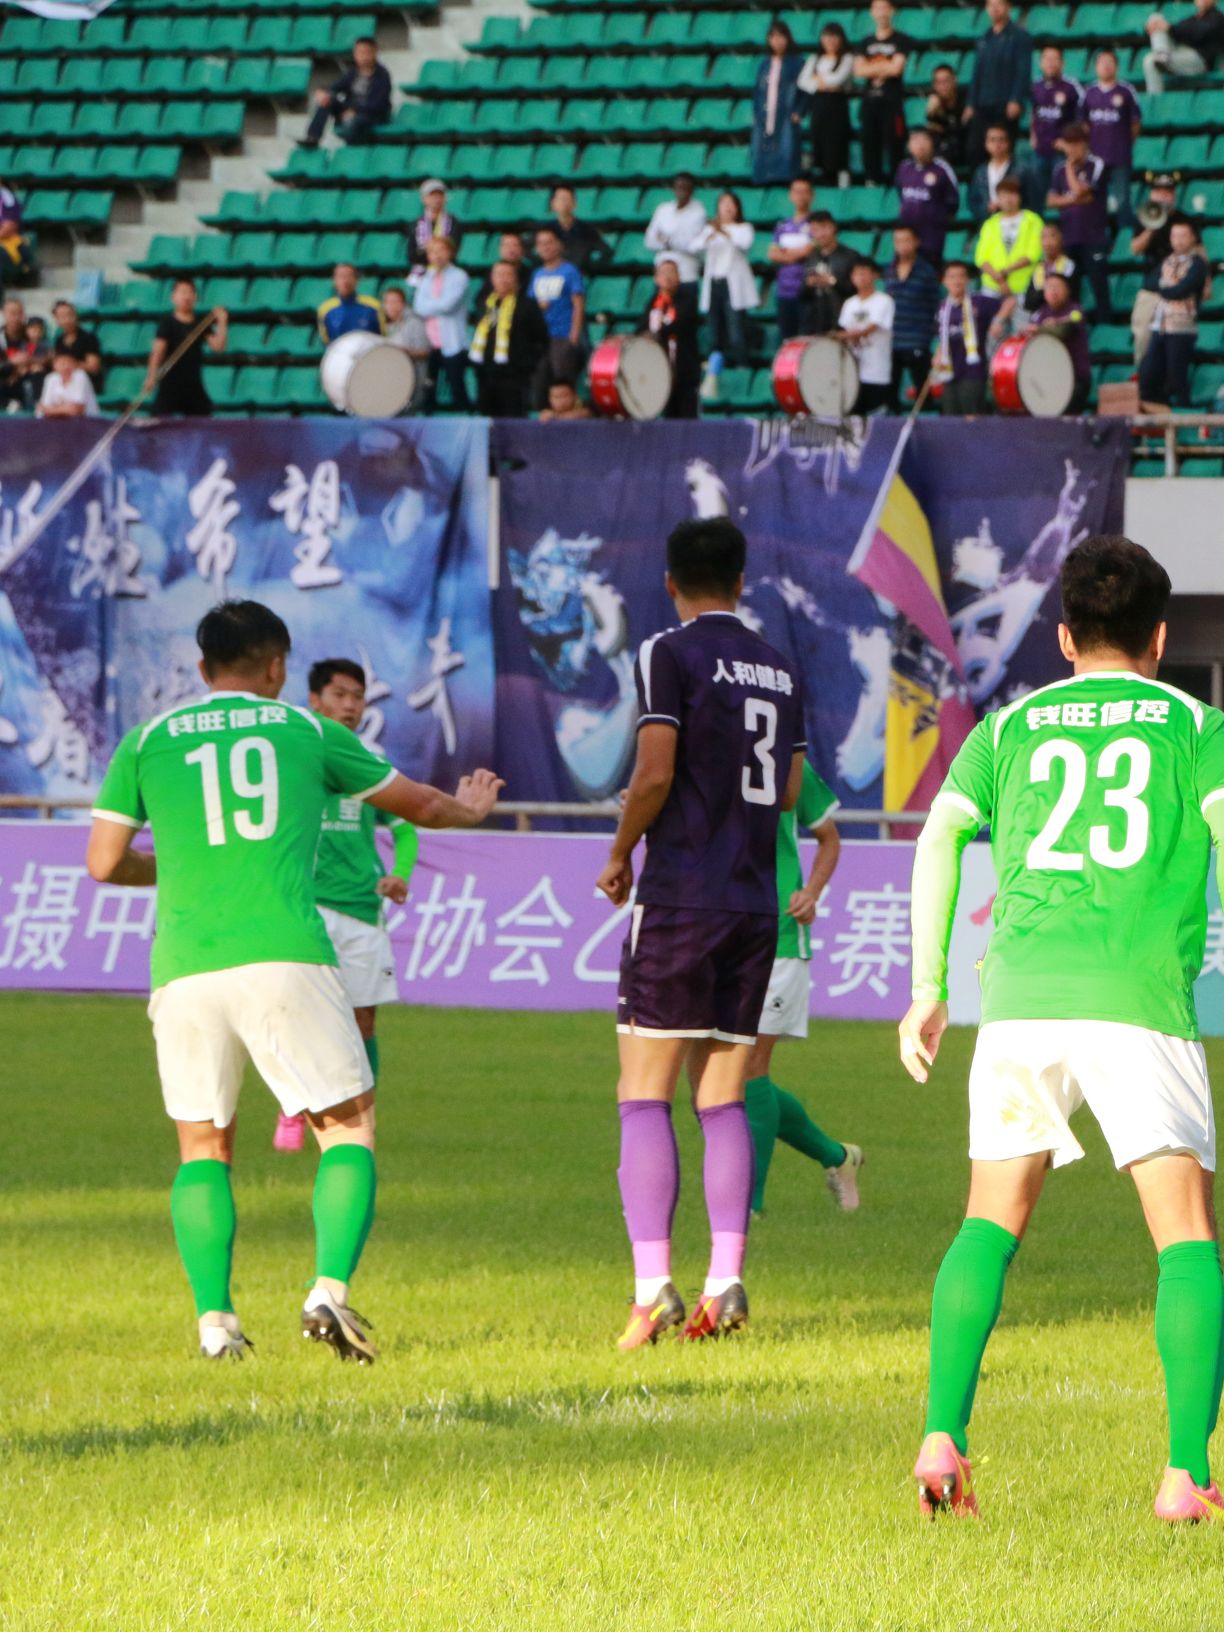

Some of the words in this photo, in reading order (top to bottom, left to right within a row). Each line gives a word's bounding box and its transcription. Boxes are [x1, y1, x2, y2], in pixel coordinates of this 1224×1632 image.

[712, 658, 794, 696] 人和健身
[185, 736, 279, 846] 19
[741, 697, 777, 806] 3
[1026, 737, 1151, 871] 23
